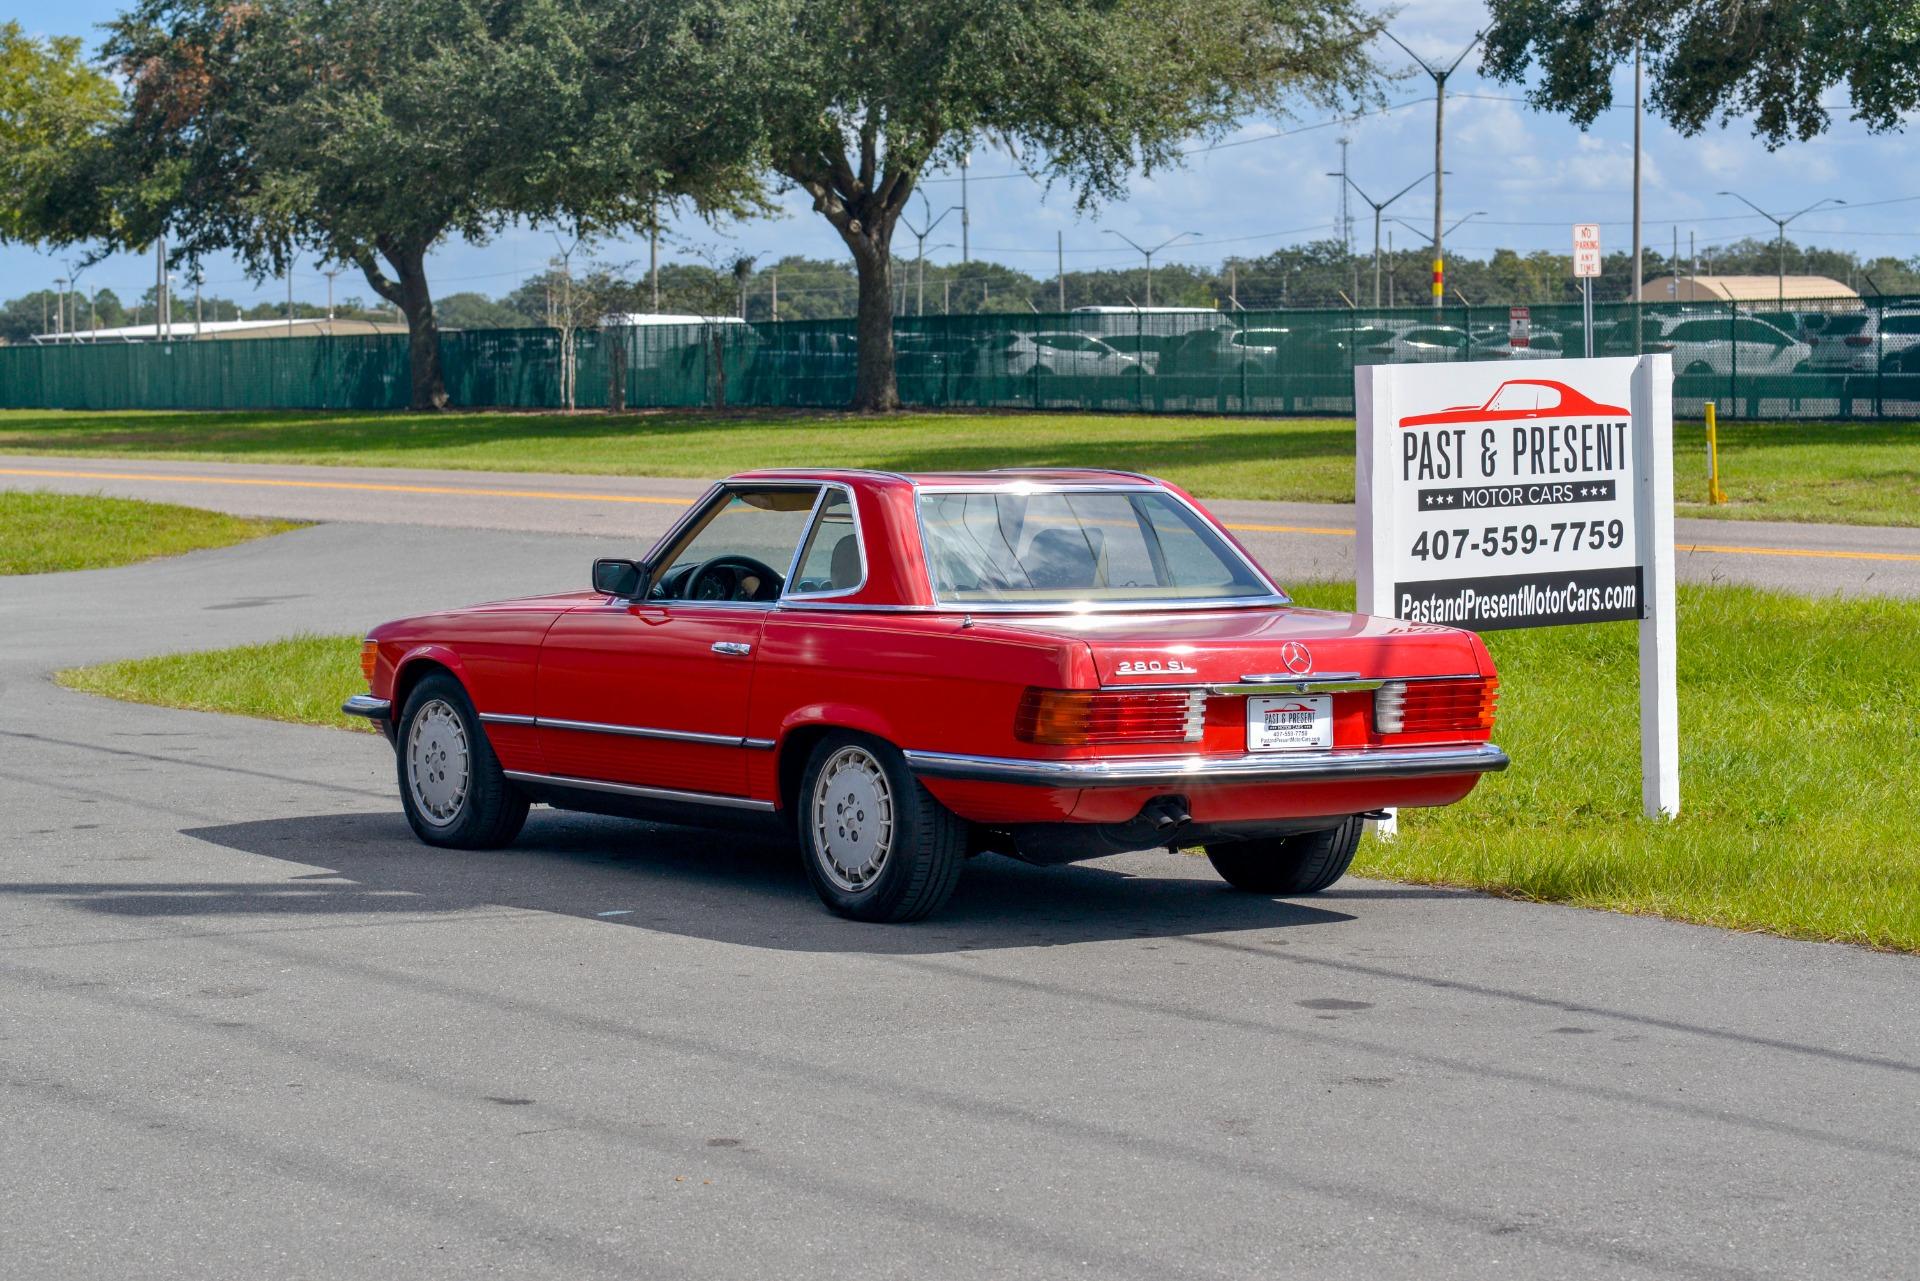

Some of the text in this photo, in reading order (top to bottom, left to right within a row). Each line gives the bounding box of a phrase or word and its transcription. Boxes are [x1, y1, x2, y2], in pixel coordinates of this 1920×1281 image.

[1581, 228, 1591, 239] NO
[1575, 240, 1599, 249] PARKING
[1580, 264, 1595, 272] TIME
[1403, 423, 1627, 481] PAST & PRESENT
[1462, 485, 1574, 507] MOTOR CARS
[1411, 519, 1624, 561] 407-559-7759
[1401, 581, 1636, 623] PastandPresentMotorCars.com
[1119, 661, 1192, 672] 280 SL
[1264, 712, 1316, 724] PAST & PRESENT
